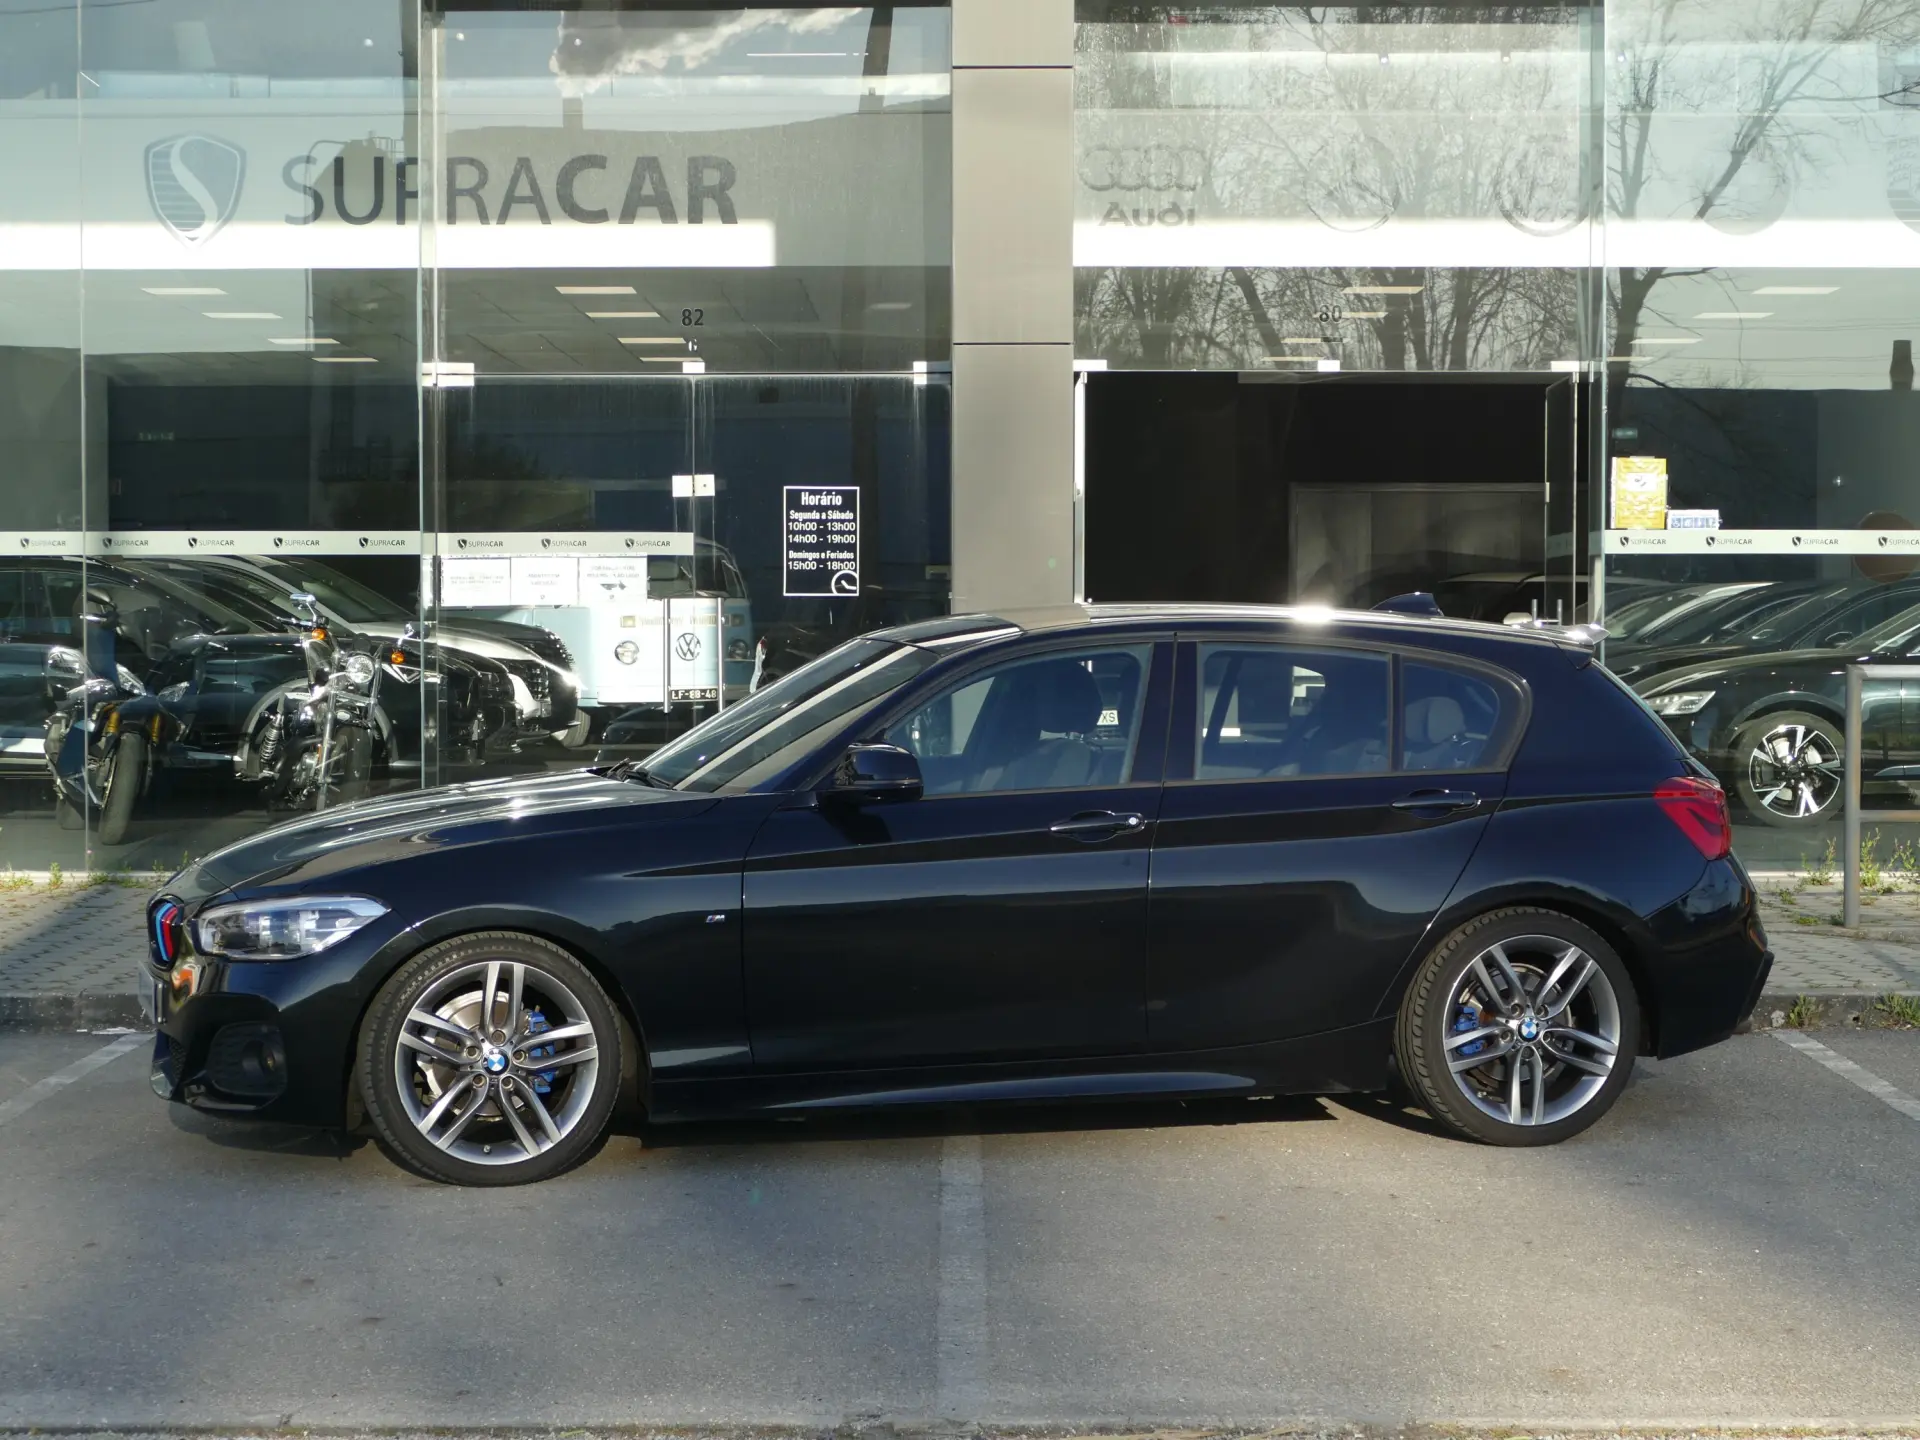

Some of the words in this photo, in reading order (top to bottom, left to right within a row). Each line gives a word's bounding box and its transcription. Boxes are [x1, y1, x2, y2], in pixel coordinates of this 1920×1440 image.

[282, 154, 738, 226] SUPRACAR
[1098, 202, 1196, 227] Audi
[681, 308, 704, 326] 82
[1319, 304, 1342, 323] 80
[801, 491, 842, 506] Horário
[789, 510, 820, 522] Segunda
[821, 512, 826, 520] a
[827, 510, 854, 520] Sábado
[788, 522, 817, 531] 10h00
[826, 522, 856, 531] 13h00
[468, 540, 504, 548] SUPRACAR
[788, 534, 817, 543] 14h00
[826, 534, 856, 543] 19h00
[1802, 538, 1839, 546] SUPRACAR
[788, 550, 820, 561] Domingos
[826, 550, 855, 559] Feriados
[788, 561, 817, 570] 15h00
[826, 561, 856, 570] 18h00
[1101, 712, 1116, 723] XS
